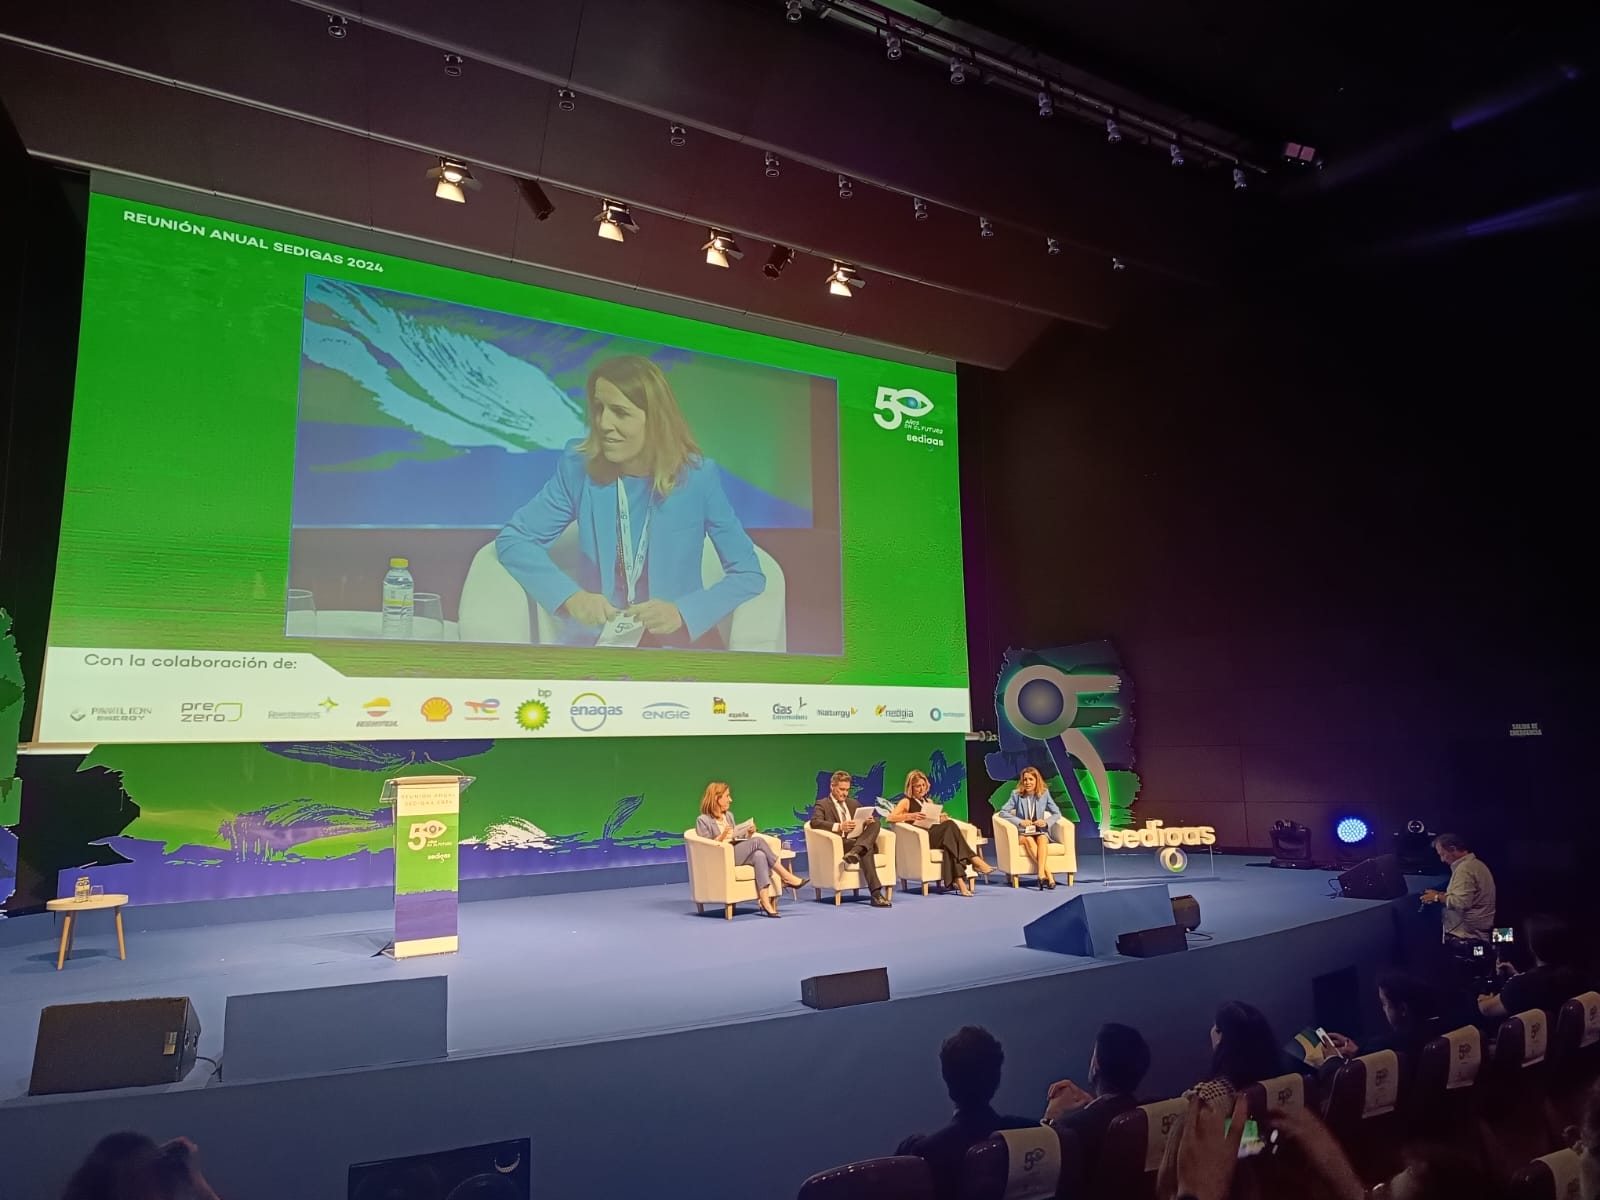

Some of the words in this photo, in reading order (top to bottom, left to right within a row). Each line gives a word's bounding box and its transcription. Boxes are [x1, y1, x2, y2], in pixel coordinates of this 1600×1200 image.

[123, 210, 206, 236] REUNIÓN
[209, 229, 269, 250] ANUAL
[273, 242, 344, 265] SEDIGAS
[346, 257, 385, 273] 2024
[84, 653, 124, 667] Con
[129, 654, 146, 667] la
[151, 655, 268, 670] colaboración
[272, 657, 298, 670] de:
[537, 688, 552, 698] bp
[181, 702, 214, 713] pre
[772, 703, 793, 715] Gas
[180, 713, 225, 723] zero
